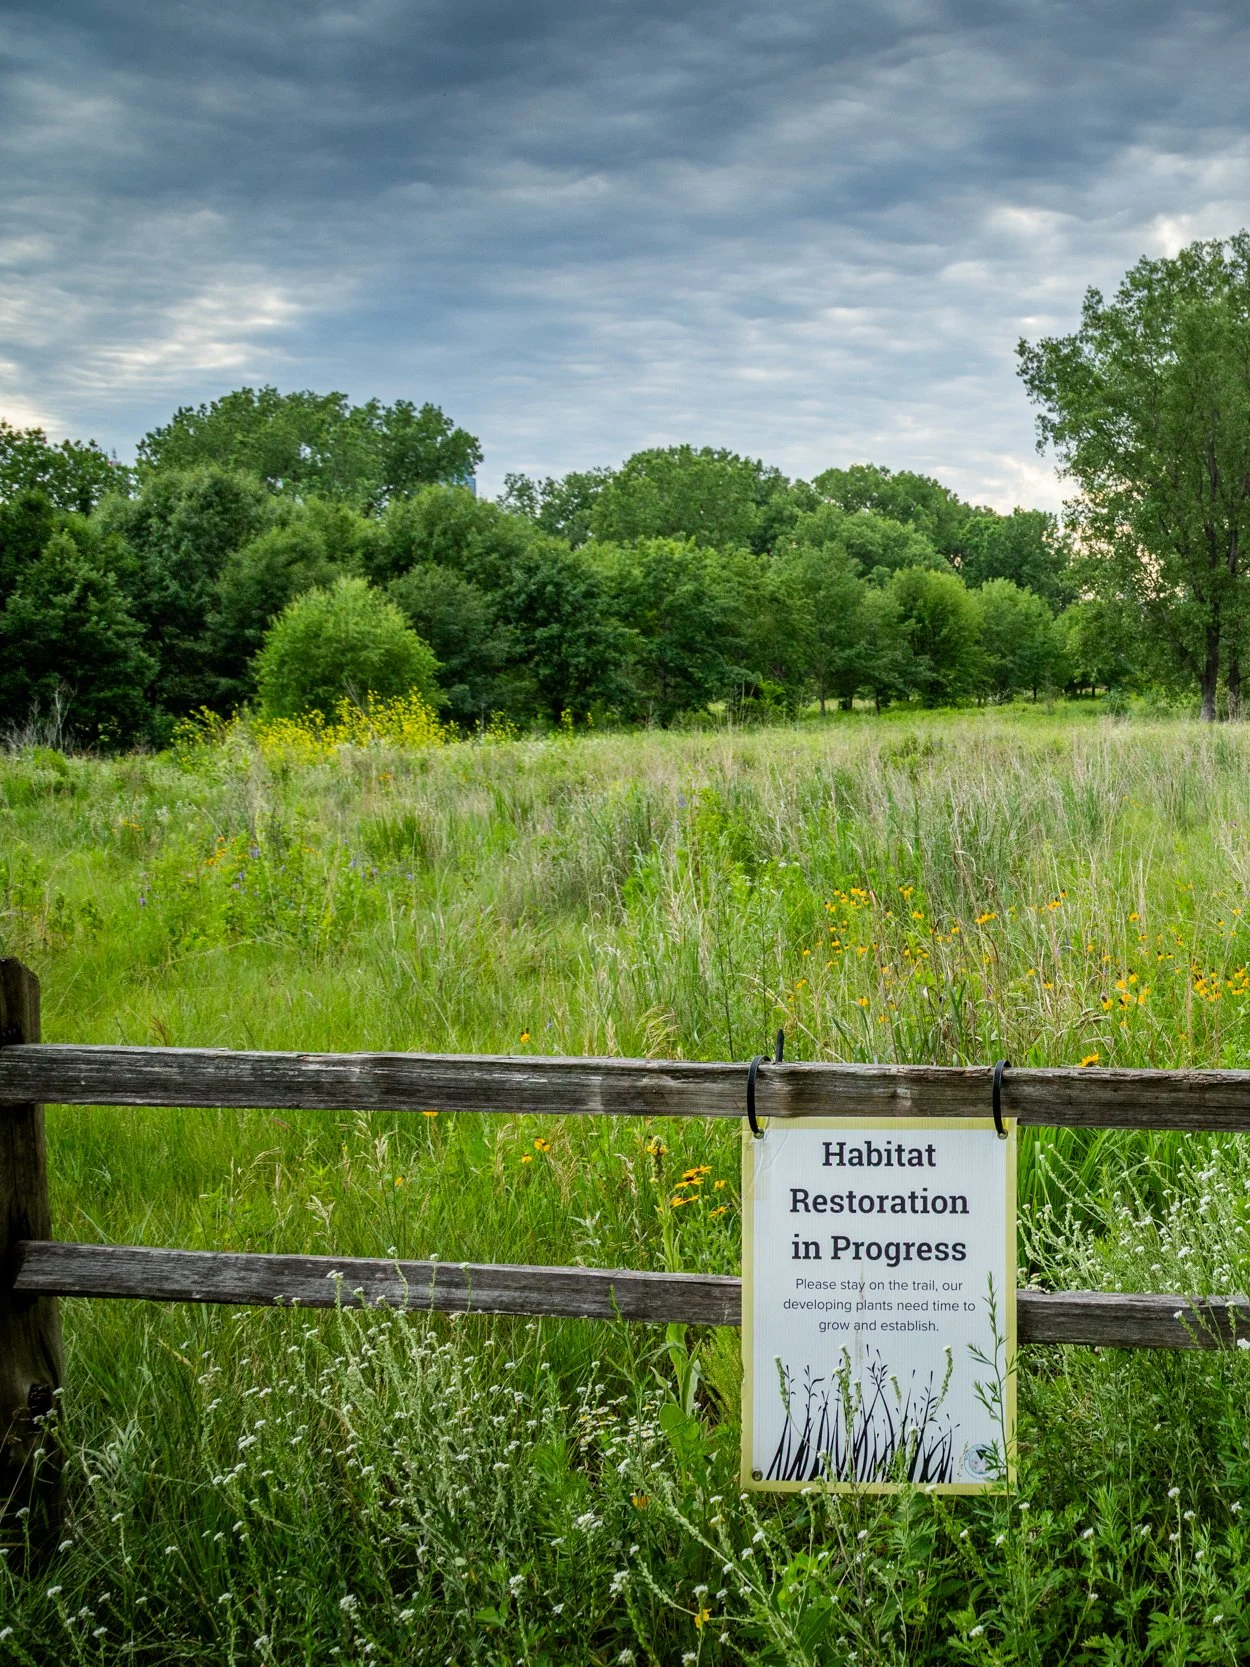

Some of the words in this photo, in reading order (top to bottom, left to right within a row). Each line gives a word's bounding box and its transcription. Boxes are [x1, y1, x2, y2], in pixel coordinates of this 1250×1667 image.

[822, 1140, 937, 1168] Habitat
[789, 1187, 970, 1215] Restoration
[791, 1233, 823, 1260] in
[830, 1235, 967, 1268] Progress
[795, 1278, 837, 1290] Please
[840, 1280, 866, 1293] stay
[868, 1281, 885, 1291] on
[888, 1279, 909, 1291] the
[912, 1279, 939, 1293] trail,
[942, 1282, 964, 1291] our
[783, 1298, 852, 1313] developing
[855, 1299, 893, 1313] plants
[896, 1300, 929, 1312] need
[932, 1300, 960, 1312] time
[963, 1301, 976, 1312] to
[818, 1321, 850, 1333] grow
[853, 1319, 877, 1331] and
[880, 1320, 939, 1332] establish.
